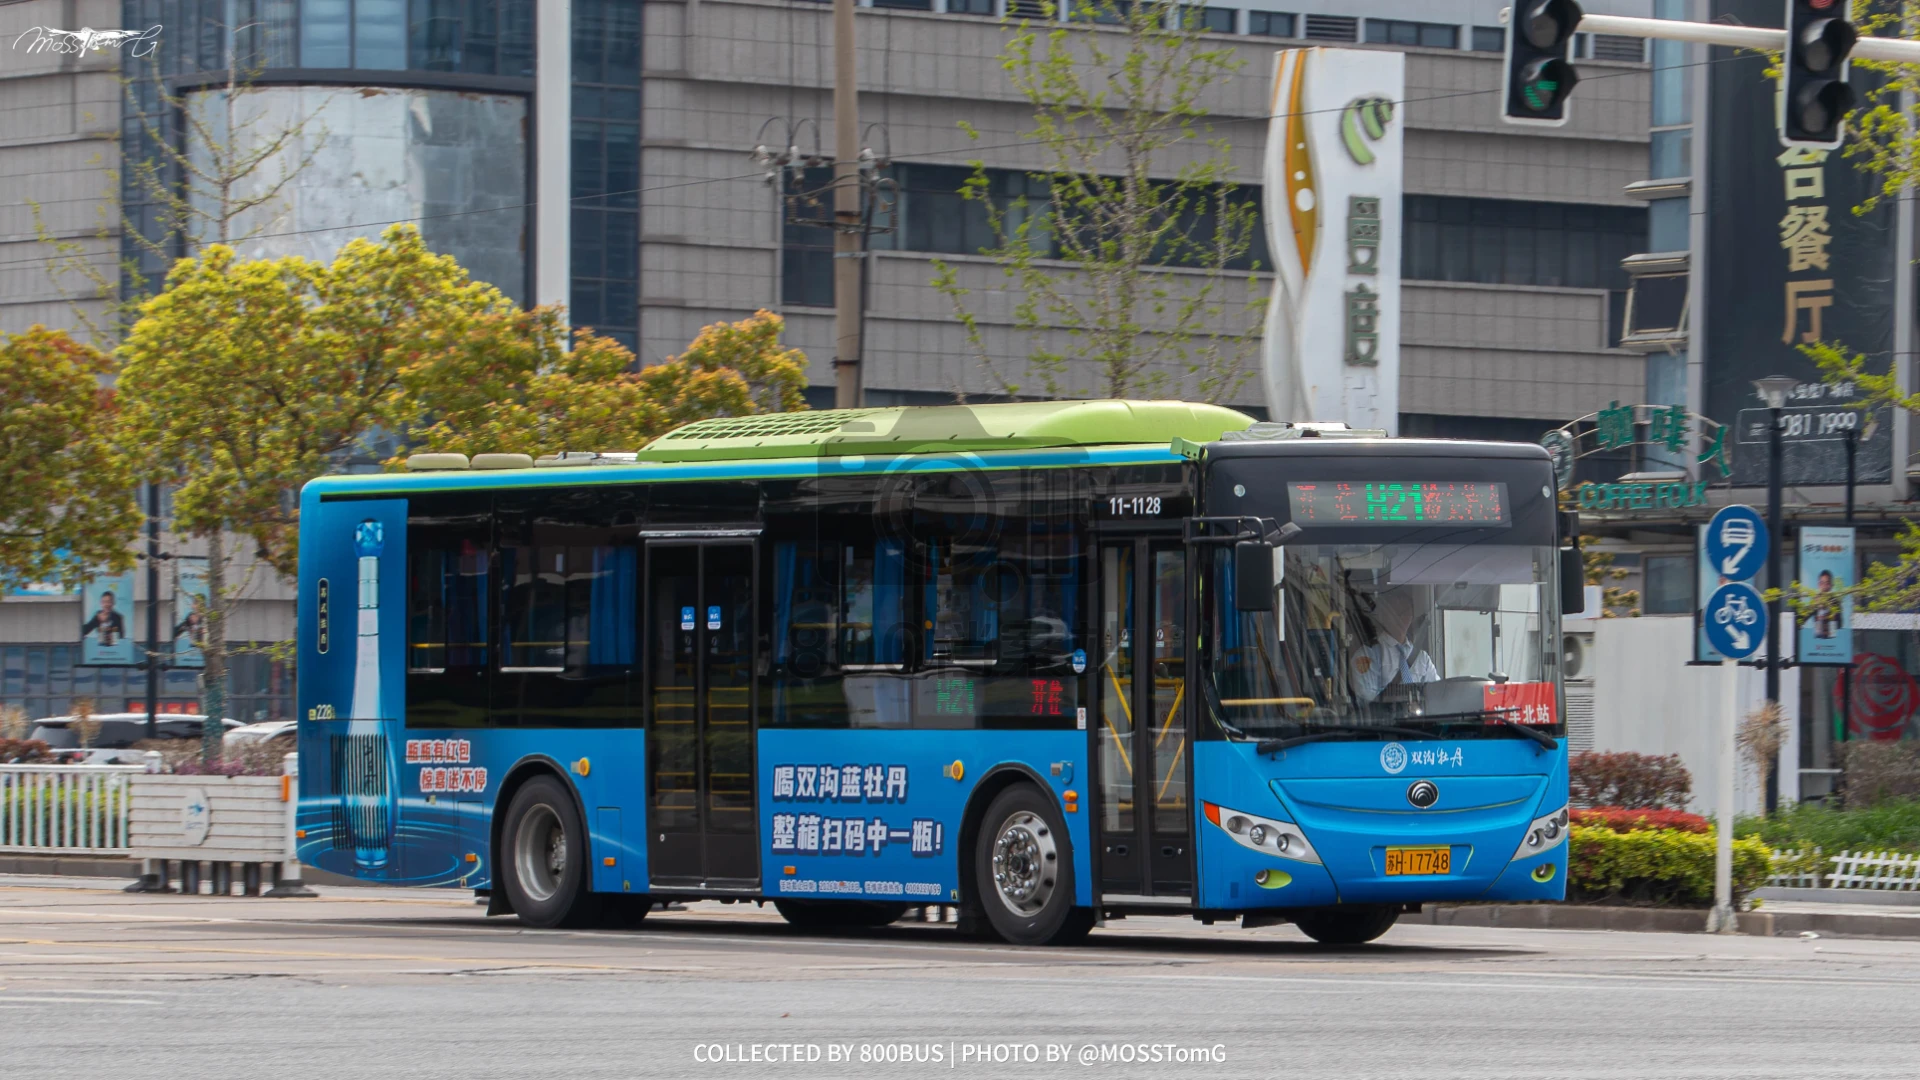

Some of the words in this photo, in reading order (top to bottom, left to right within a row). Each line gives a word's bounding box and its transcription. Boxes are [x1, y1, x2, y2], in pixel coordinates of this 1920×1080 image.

[1344, 195, 1380, 367] 曼度
[1109, 496, 1162, 515] 11-1128
[1365, 483, 1424, 521] H21
[1579, 482, 1652, 511] COFFEE
[1656, 480, 1708, 509] FOLK
[937, 679, 974, 714] H21
[420, 767, 488, 793] 惊喜送不停
[773, 765, 907, 800] 喝双沟蓝牡丹
